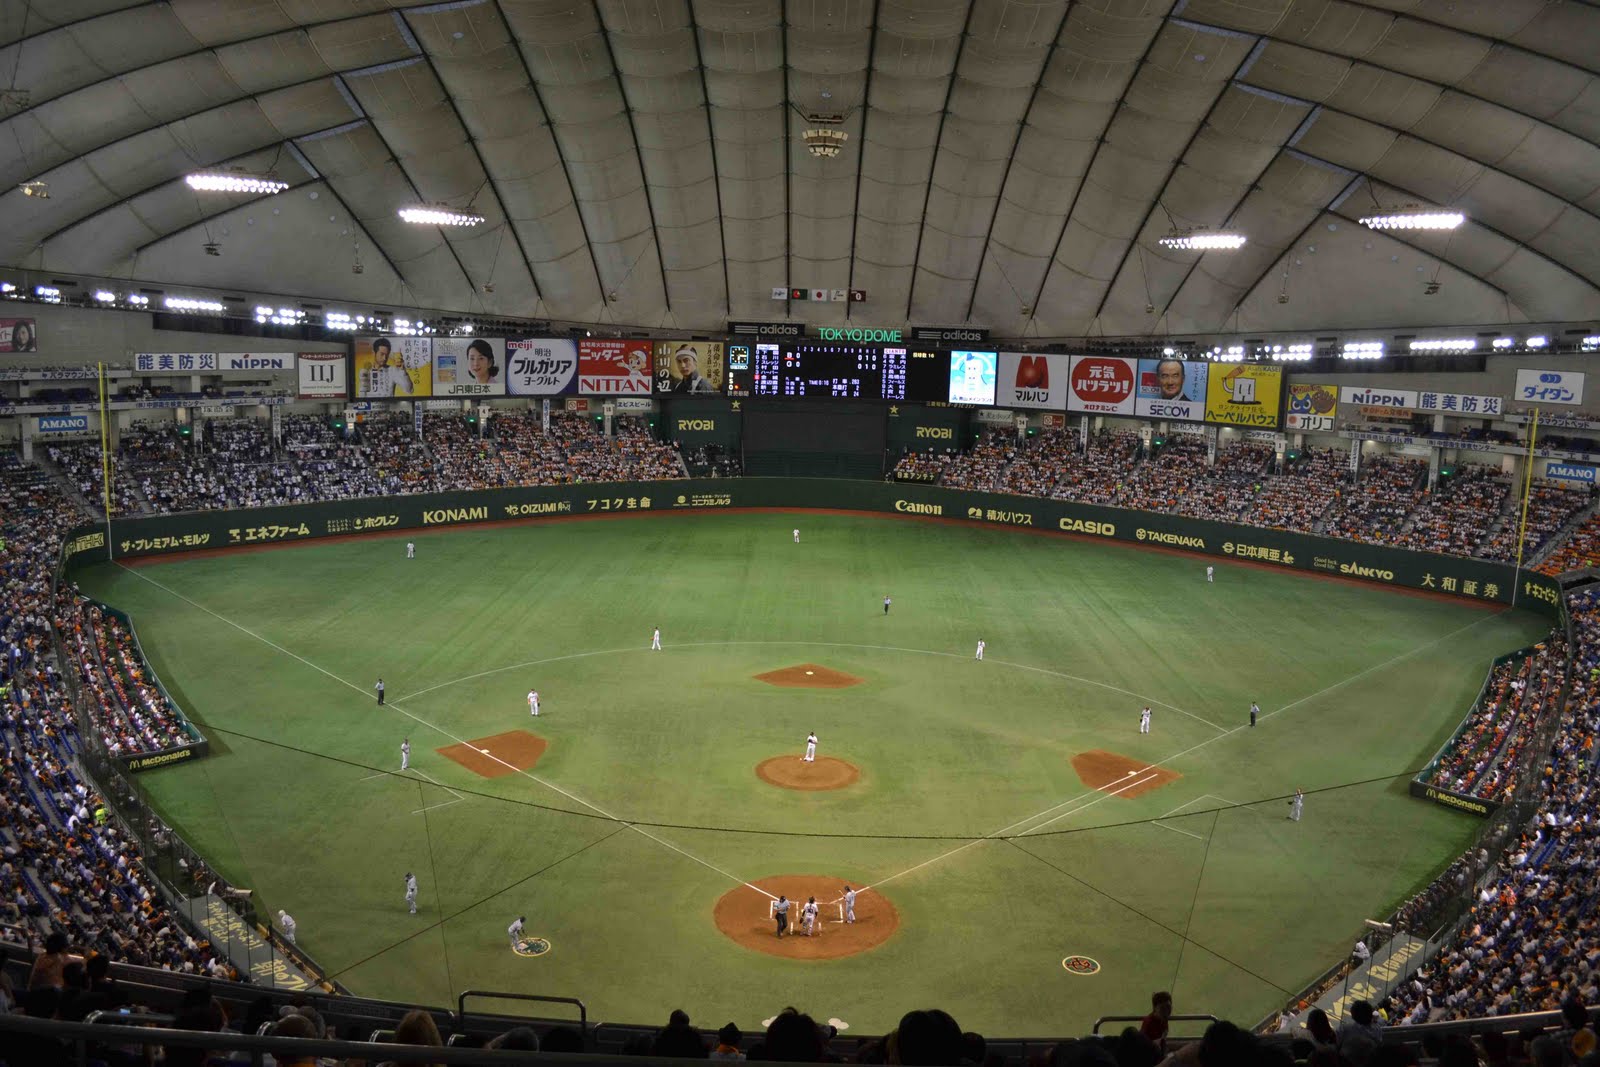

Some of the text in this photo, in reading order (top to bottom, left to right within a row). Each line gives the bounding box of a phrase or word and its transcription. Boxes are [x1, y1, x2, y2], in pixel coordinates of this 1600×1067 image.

[760, 326, 798, 335] adidas
[818, 328, 902, 342] TOKYO DOME
[943, 331, 981, 341] adidas
[508, 341, 532, 350] meiji
[535, 348, 551, 357] 明治
[580, 349, 624, 360] ニッタン
[137, 354, 214, 370] 能美防災
[514, 358, 572, 375] ブルガリア
[309, 365, 336, 383] IIJ
[1090, 366, 1115, 379] 元気
[524, 376, 560, 386] ヨーグルト
[581, 379, 650, 392] NITTAN
[448, 385, 491, 394] JR東日本
[1015, 390, 1049, 402] マルハン
[1524, 385, 1574, 401] ダイダン
[1422, 393, 1498, 413] 能美防災
[1150, 405, 1189, 418] SECOM
[1207, 410, 1276, 425] ヘーベルハウス
[41, 419, 85, 429] AMANO
[678, 420, 714, 431] RYOBI
[1300, 416, 1333, 431] オリコ
[916, 427, 952, 439] RYOBI
[897, 472, 934, 481] 日本アンテナ
[1549, 467, 1592, 478] AMANO
[520, 503, 557, 514] OIZUMI
[587, 497, 651, 510] フコク生命
[895, 500, 942, 516] Canon
[364, 515, 399, 528] ホクレン
[423, 506, 488, 524] KONAMI
[986, 509, 1032, 525] 積水ハウス
[245, 523, 310, 541] エネファーム
[1060, 517, 1115, 536] CASIO
[121, 532, 210, 552] ザ・プレミアム・モルツ
[1148, 531, 1205, 548] TAKENAKA
[1236, 544, 1280, 562] 日本興亜
[1340, 561, 1394, 581] SANKYO
[1421, 573, 1498, 598] 大和証券
[142, 750, 190, 768] McDonald's
[1438, 792, 1487, 813] McDonald's
